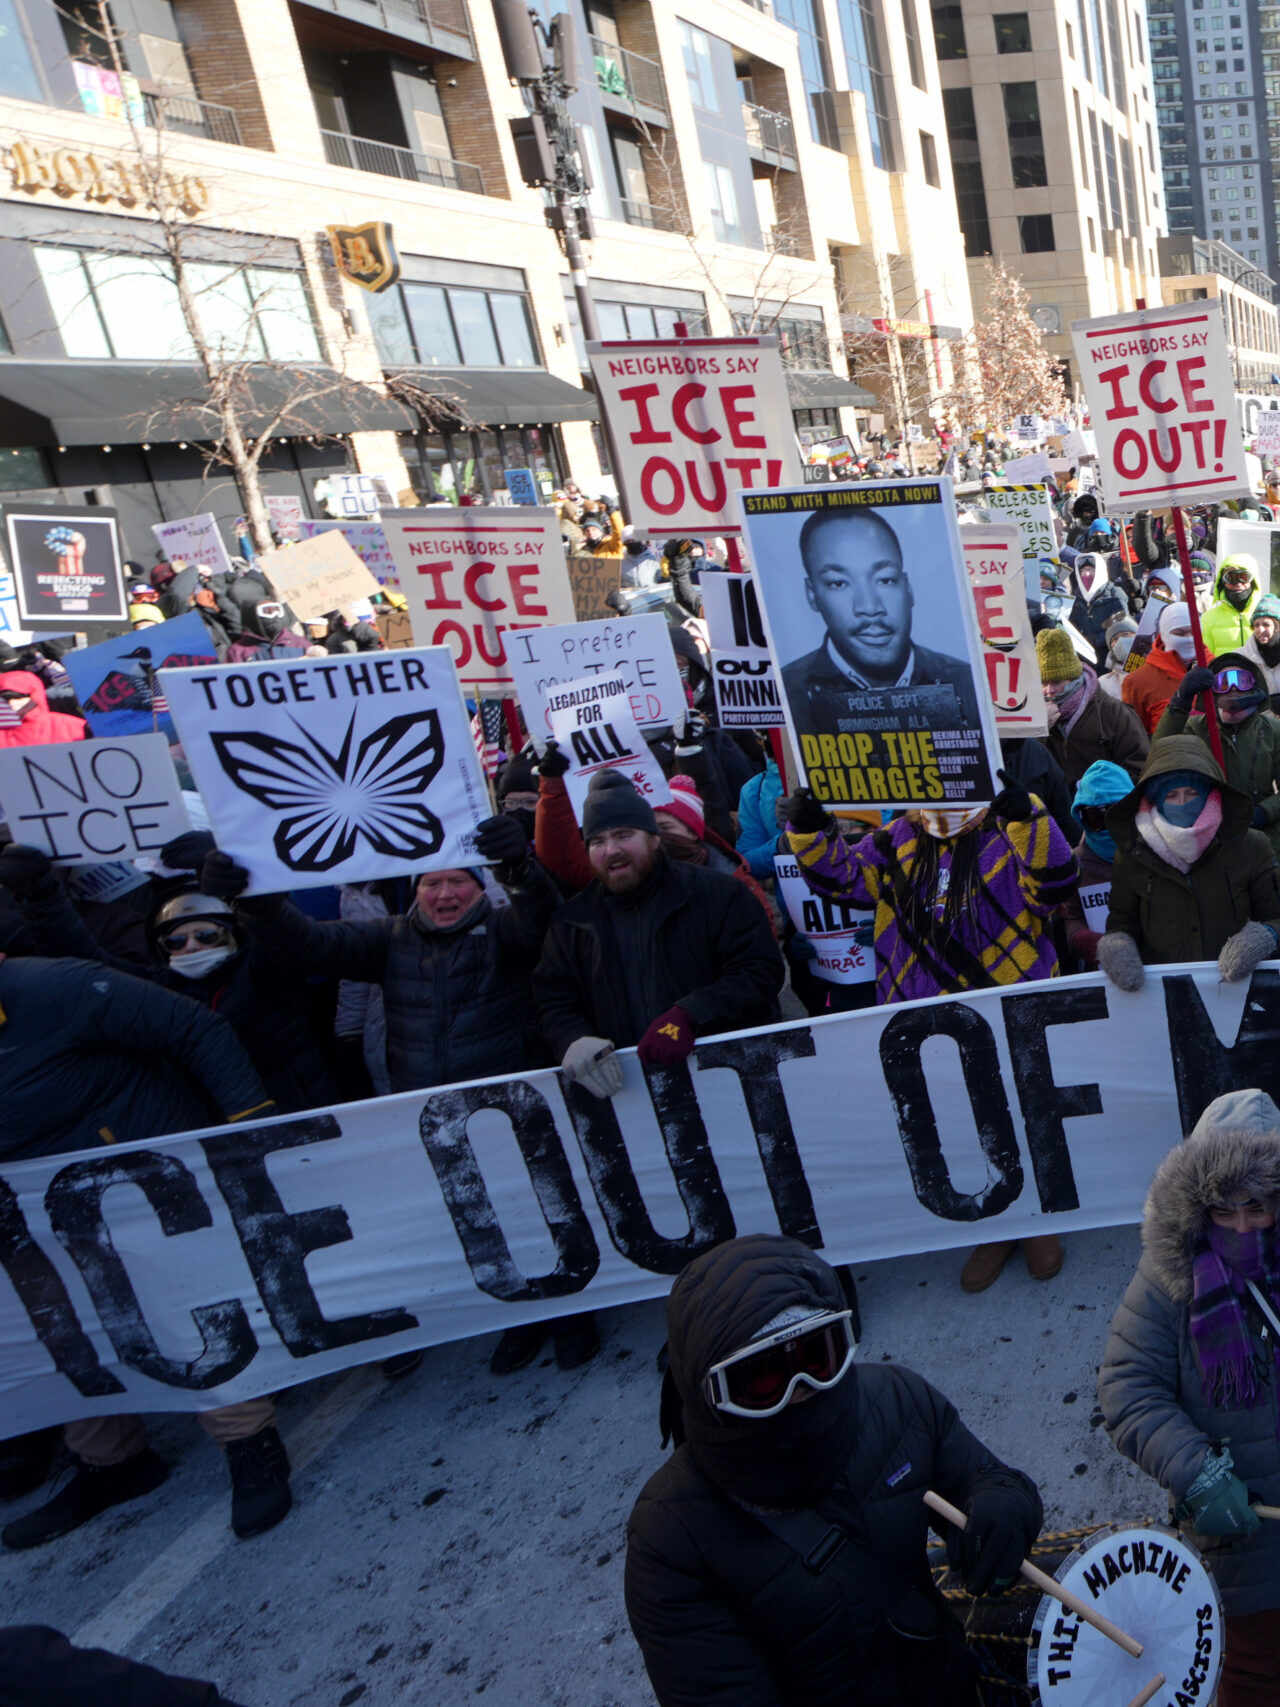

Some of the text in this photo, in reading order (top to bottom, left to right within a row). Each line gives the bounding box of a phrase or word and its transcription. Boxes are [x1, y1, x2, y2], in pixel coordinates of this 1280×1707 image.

[1091, 332, 1209, 363] NEIGHBORS SAY
[608, 357, 760, 378] NEIGHBORS SAY
[1098, 355, 1215, 421] ICE
[619, 383, 767, 449] ICE
[1113, 419, 1227, 480] OUT!
[511, 473, 529, 484] ICE
[512, 484, 532, 495] OUT
[746, 486, 938, 511] STAND WITH MINNESOTA NOW!
[989, 492, 1047, 508] RELEASE
[1006, 510, 1032, 518] THE
[408, 540, 544, 557] NEIGHBORS SAY
[980, 561, 1009, 575] SAY
[417, 561, 548, 617] ICE
[516, 626, 637, 665] I prefer
[90, 674, 136, 712] ICE
[191, 658, 430, 710] TOGETHER
[549, 677, 626, 712] LEGALIZATION
[576, 703, 604, 723] FOR
[848, 693, 921, 711] POLICE DEPT
[724, 713, 760, 725] PARTY FOR
[838, 715, 931, 731] BIRMINGHAM ALA
[963, 730, 981, 739] LEVY
[570, 723, 632, 766] ALL
[801, 731, 938, 768] DROP THE
[22, 747, 143, 809] NO
[807, 765, 945, 801] CHARGES
[943, 780, 976, 790] WILLIAM
[19, 802, 170, 861] ICE
[802, 900, 858, 932] ALL
[0, 1113, 419, 1396] ICE
[419, 1025, 823, 1302] OUT
[879, 986, 1109, 1222] OF
[773, 1328, 805, 1344] SCOTT
[1082, 1541, 1192, 1600] MACHINE
[1166, 1603, 1213, 1707] ASCISTS
